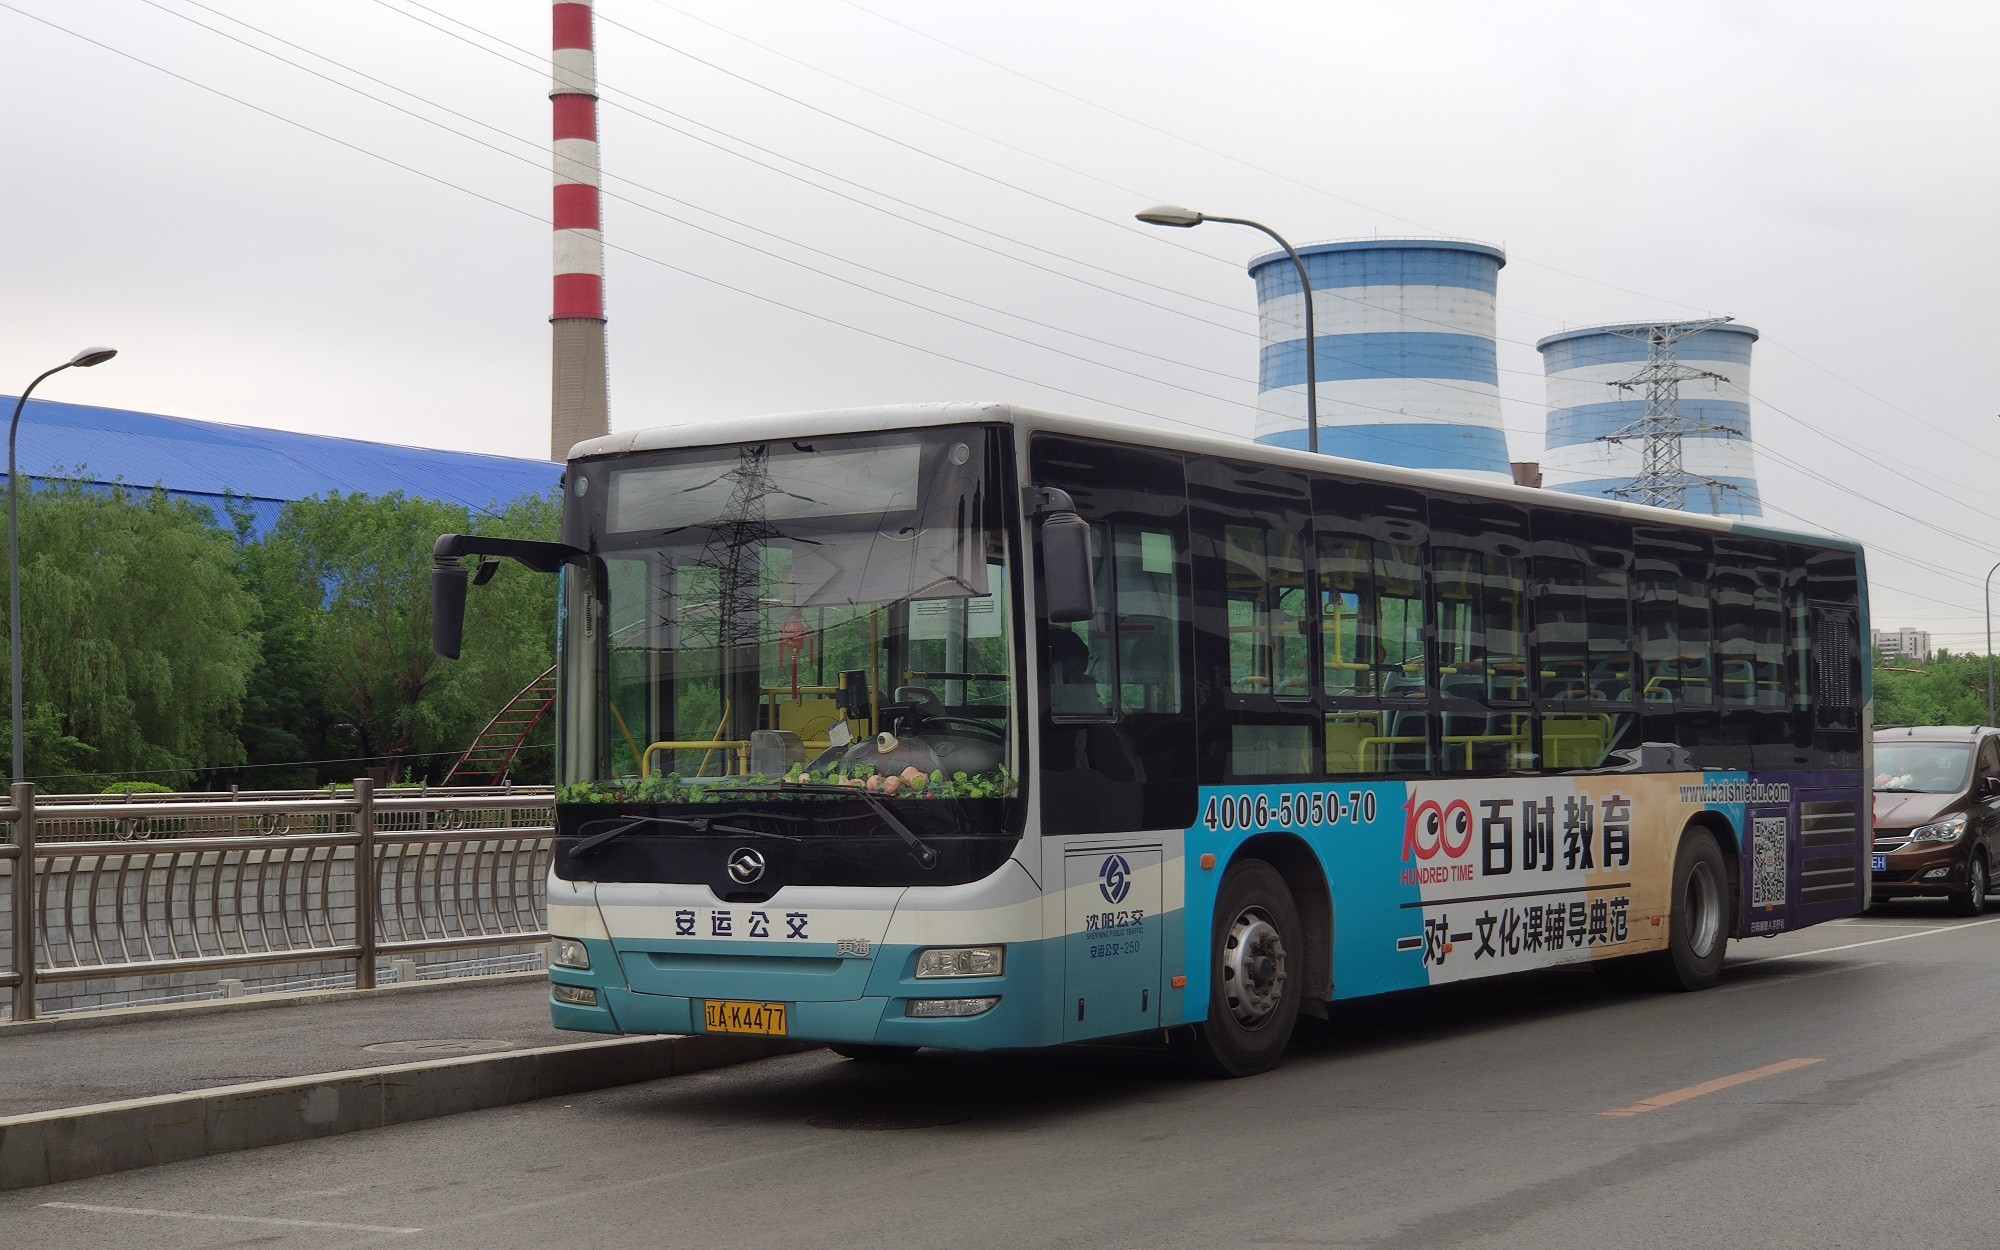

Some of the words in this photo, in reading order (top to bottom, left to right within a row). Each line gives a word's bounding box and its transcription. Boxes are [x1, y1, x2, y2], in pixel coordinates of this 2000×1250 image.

[1680, 779, 1789, 803] www.baishiedu.com
[1203, 790, 1377, 831] 4006-5050-70
[1401, 786, 1473, 862] 100
[1479, 794, 1631, 876] 百时教育
[1401, 866, 1449, 886] HUNDRED
[1450, 864, 1474, 882] TIME
[675, 910, 809, 939] 安运公交
[1086, 910, 1144, 931] 沈阳公交
[1086, 930, 1109, 940] SHENYANG
[1109, 928, 1125, 938] PUBLIC
[1126, 926, 1144, 935] TRAFFIC
[1397, 896, 1630, 966] 一对一文化课辅导典范
[1090, 940, 1140, 959] 安运公交-250
